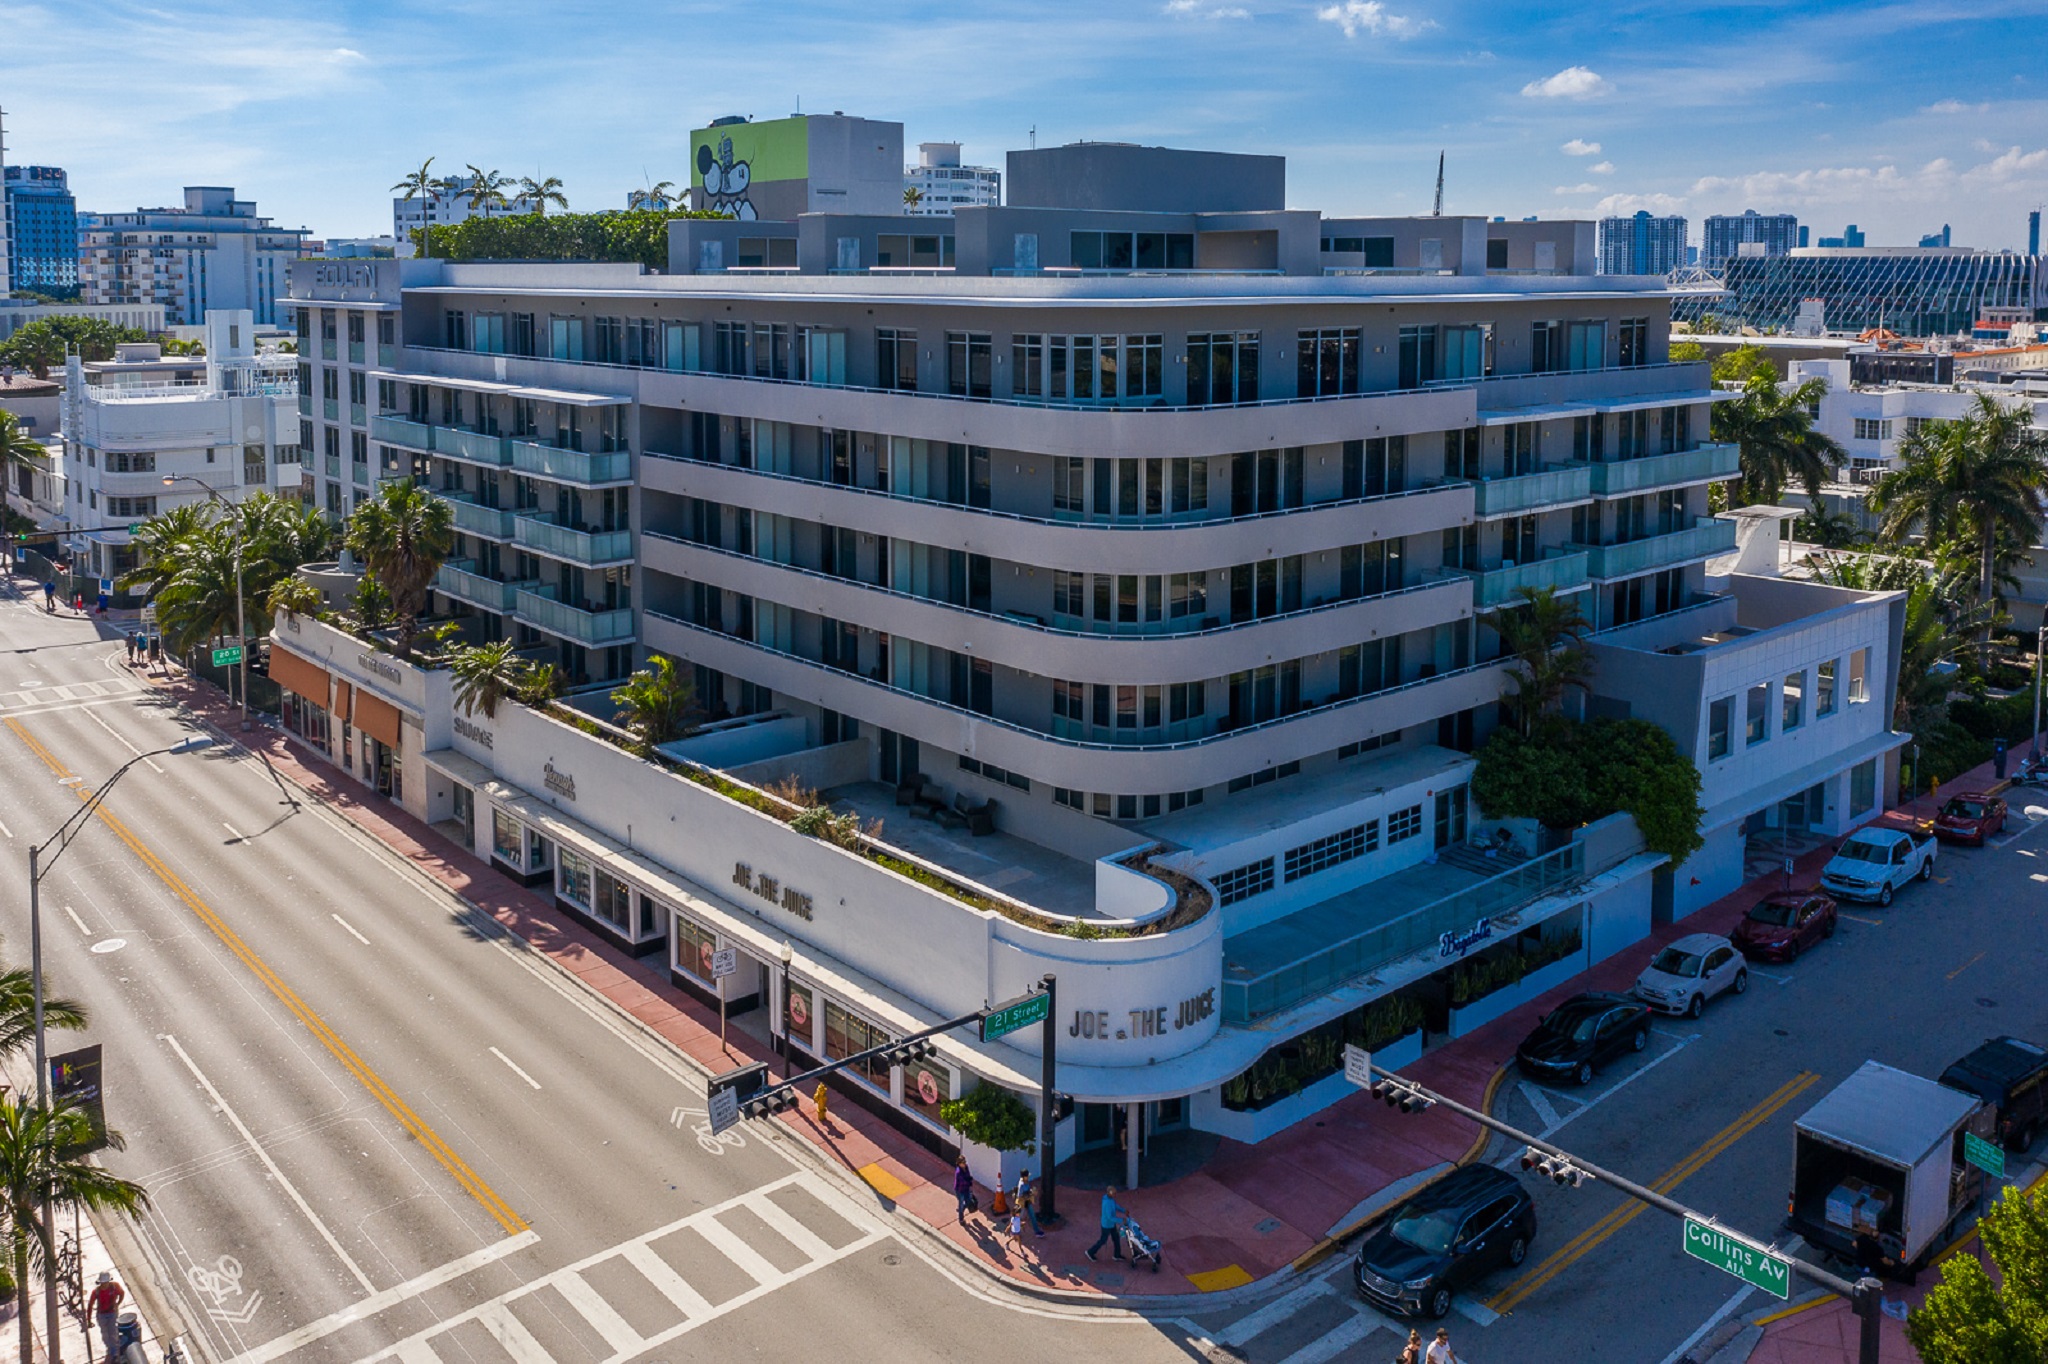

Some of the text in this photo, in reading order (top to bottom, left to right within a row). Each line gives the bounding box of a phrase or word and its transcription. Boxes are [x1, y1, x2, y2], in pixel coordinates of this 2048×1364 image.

[732, 862, 752, 892] JOE
[758, 873, 779, 906] THE
[781, 887, 813, 922] JUICE
[994, 1002, 1040, 1028] 21 Street
[1069, 1010, 1109, 1041] JOE
[1128, 1007, 1168, 1039] THE
[1174, 987, 1215, 1031] JUICE
[1688, 1223, 1785, 1281] Collins Av
